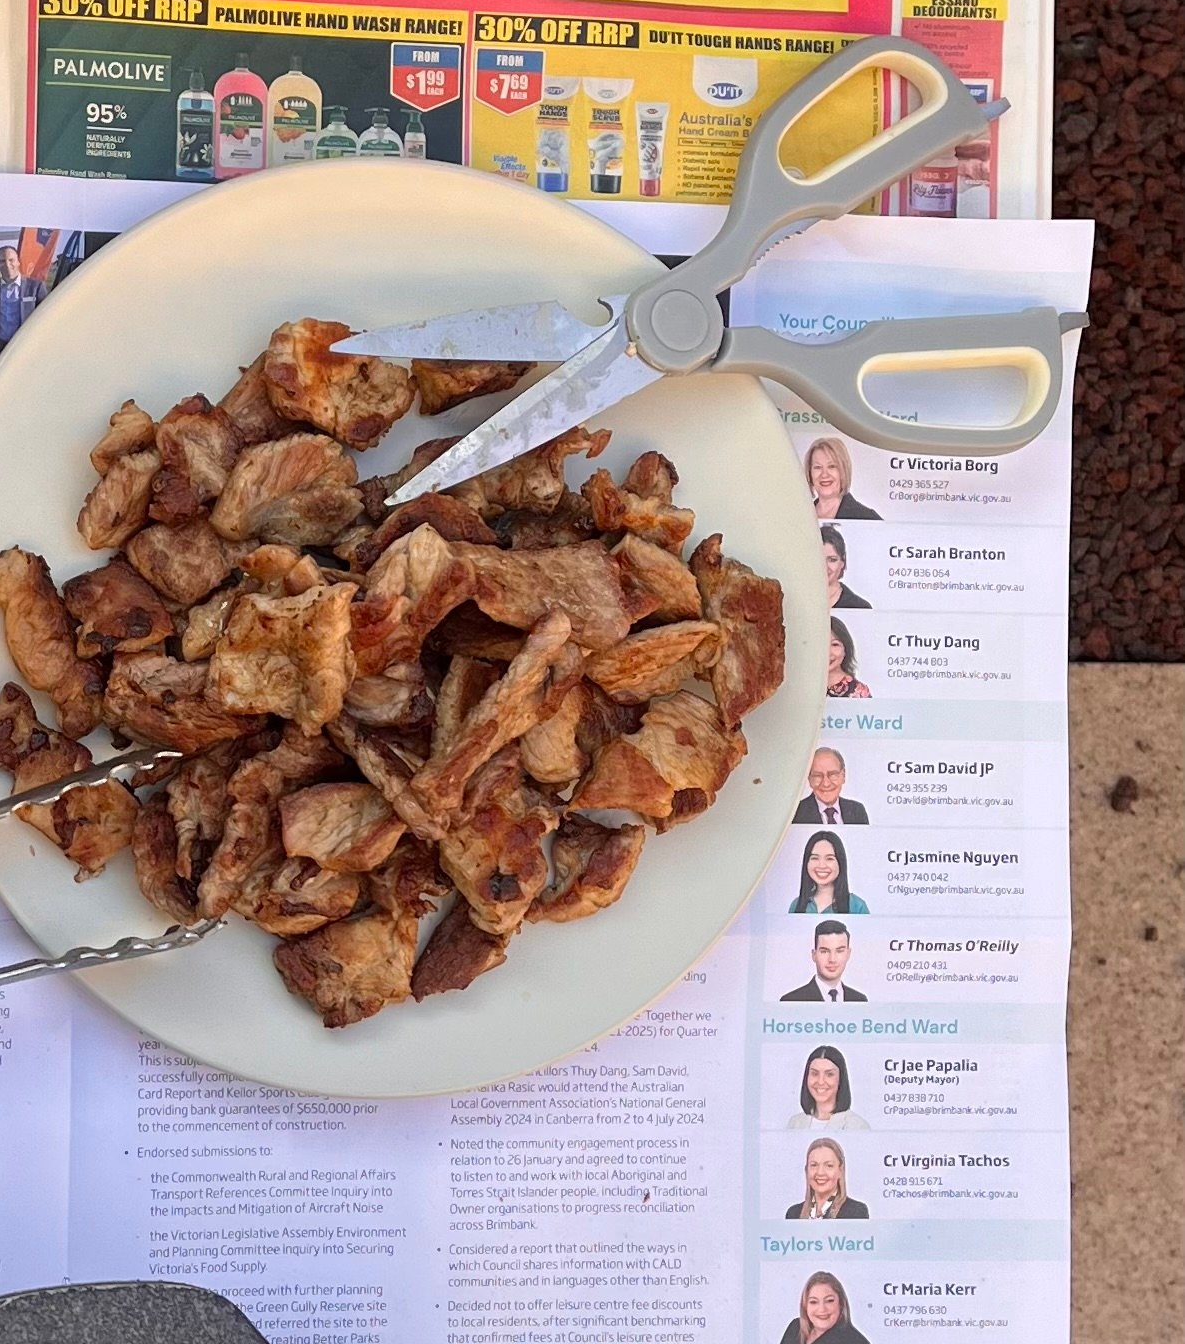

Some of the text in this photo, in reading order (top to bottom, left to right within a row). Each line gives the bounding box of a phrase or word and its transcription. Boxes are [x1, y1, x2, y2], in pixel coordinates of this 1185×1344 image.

[912, 5, 998, 20] DEODORANTS!
[215, 7, 463, 36] PALMOLIVE HAND WASH RANGE!
[479, 16, 635, 47] 30% OFF RRP
[687, 32, 731, 49] TOUGH
[734, 35, 783, 53] HANDS
[785, 37, 835, 55] RANGE!
[412, 50, 440, 63] FROM
[496, 54, 524, 67] FROM
[53, 58, 164, 83] PALMOLIVE
[86, 103, 128, 124] 95%
[679, 110, 753, 128] Australia's
[779, 314, 818, 329] Your
[890, 457, 997, 474] Cr Victoria Borg
[889, 545, 1005, 560] Cr Sarah Branton
[888, 634, 979, 651] Cr Thuy Dang
[857, 715, 903, 730] Ward
[887, 761, 993, 777] Cr Sam David JP
[887, 850, 1017, 866] Cr Jasmine Nguyen
[889, 939, 1018, 954] Cr Thomas O'Reilly
[763, 1018, 957, 1033] Horseshoe Bend Ward
[884, 1059, 977, 1074] Cr Jae Papalia
[137, 1146, 273, 1158] Endorsed submissions to:
[883, 1154, 1009, 1169] Cr Virginia Tachos
[449, 1219, 537, 1230] across Brimbank.
[760, 1235, 873, 1255] Taylors Ward
[883, 1283, 975, 1295] Cr Maria Kerr
